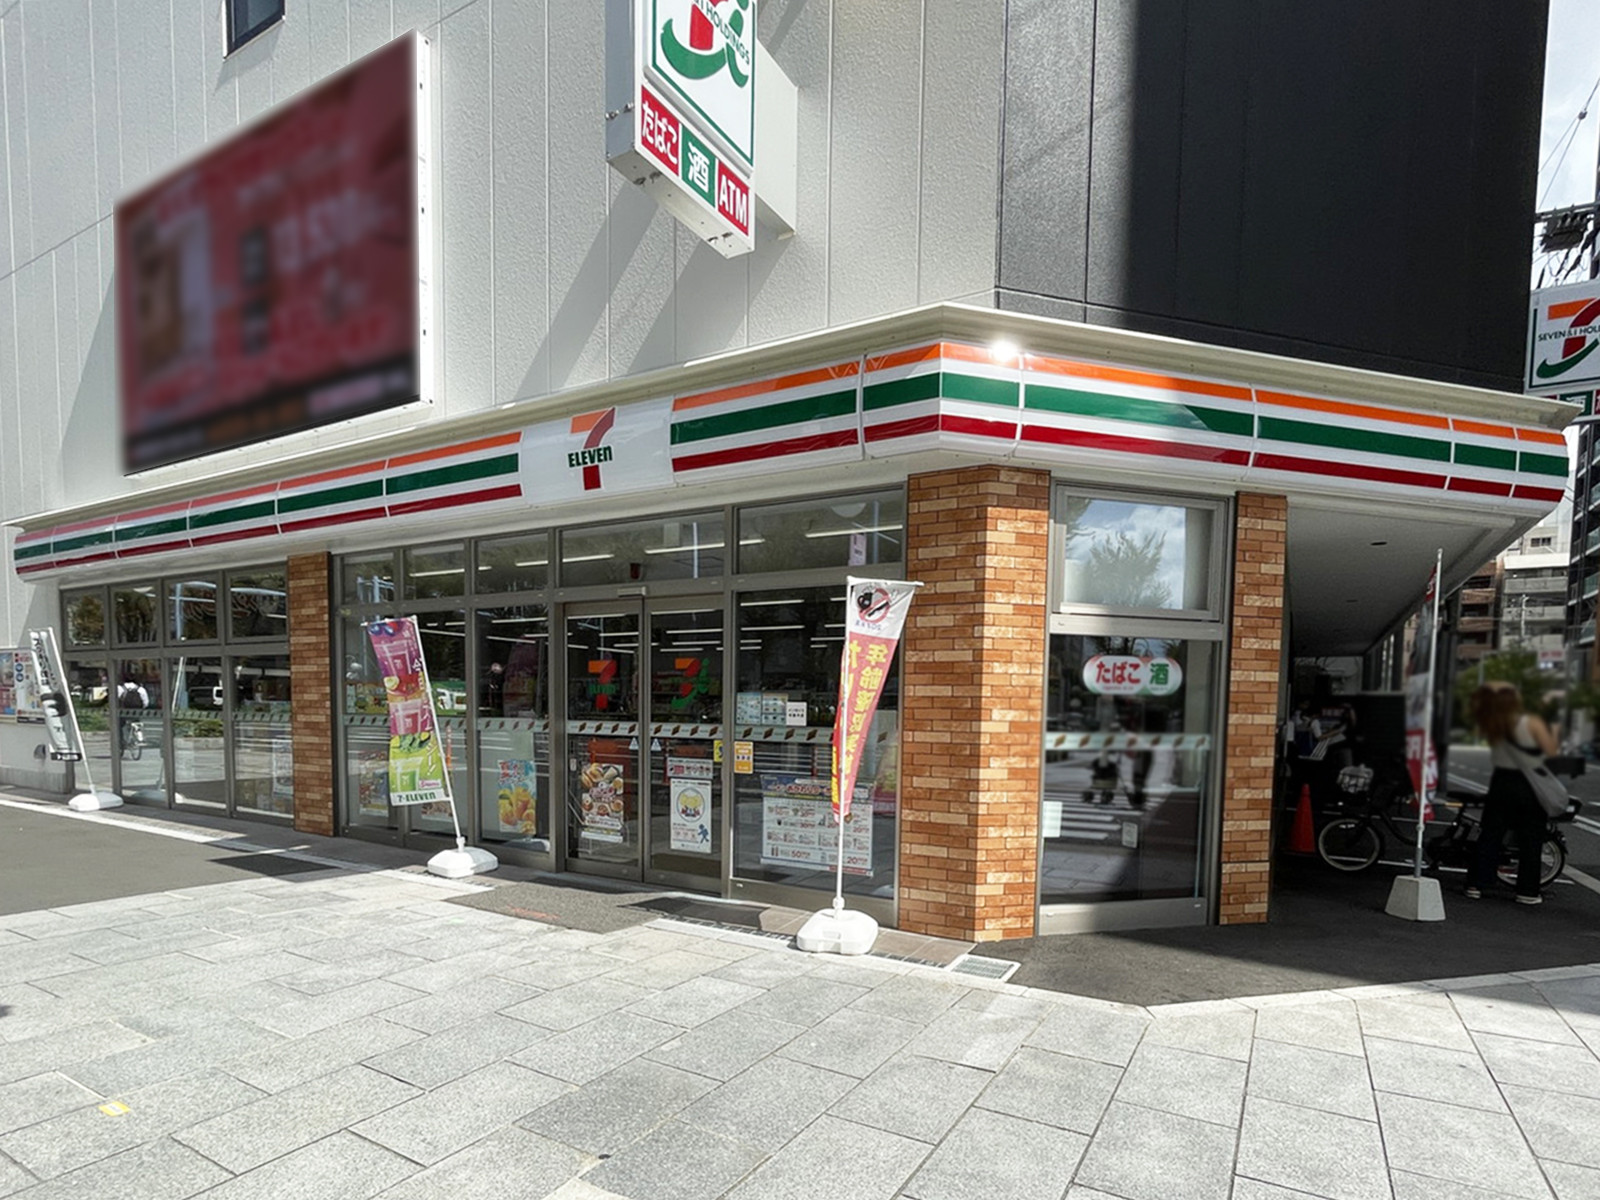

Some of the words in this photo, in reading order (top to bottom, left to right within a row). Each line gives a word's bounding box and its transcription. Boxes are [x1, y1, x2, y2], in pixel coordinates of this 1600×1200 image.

[706, 1, 750, 65] HOLDINGS
[642, 101, 678, 165] たばこ
[688, 141, 710, 193] 酒
[719, 174, 748, 227] ATM
[1096, 661, 1141, 685] たばこ
[1150, 662, 1169, 685] 酒
